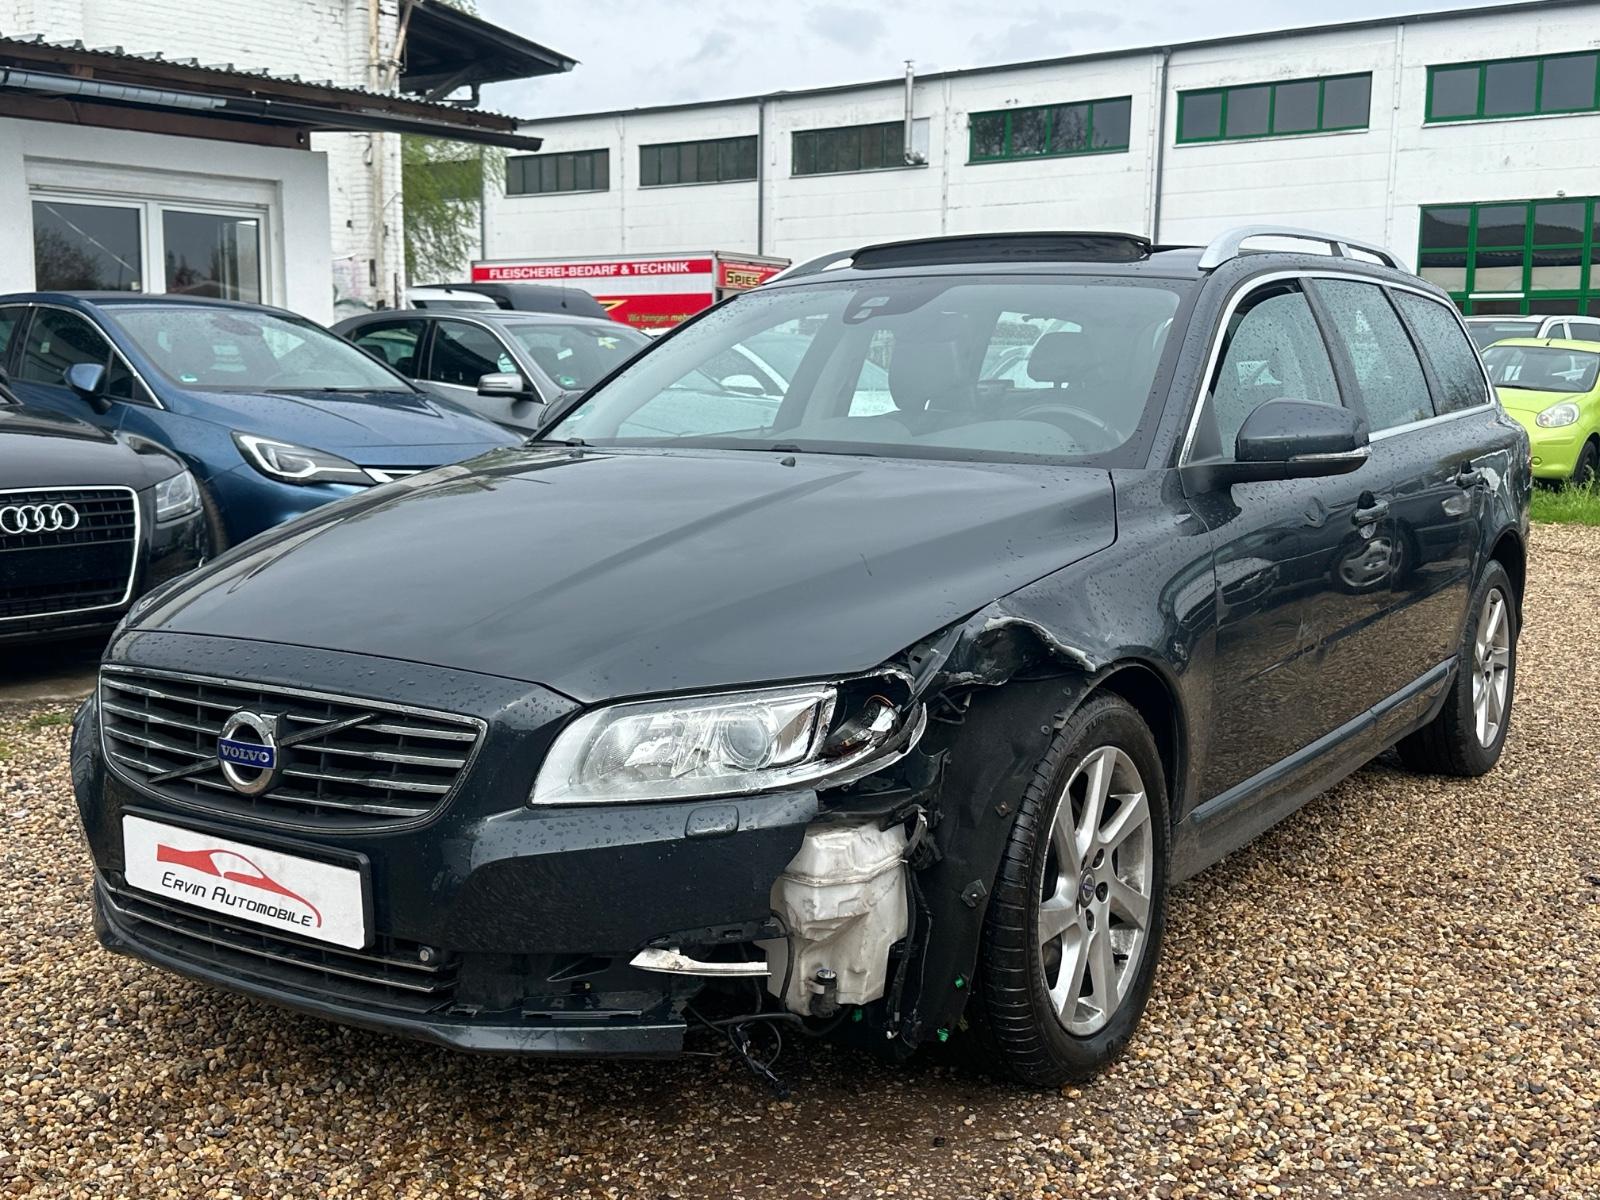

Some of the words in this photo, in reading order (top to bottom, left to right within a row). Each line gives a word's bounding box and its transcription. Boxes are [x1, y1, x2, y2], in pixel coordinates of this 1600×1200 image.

[489, 265, 618, 280] FLEISCHEREI-BEDARF
[620, 264, 630, 275] &
[632, 262, 690, 275] TECHNIK
[221, 744, 270, 763] VOLVO
